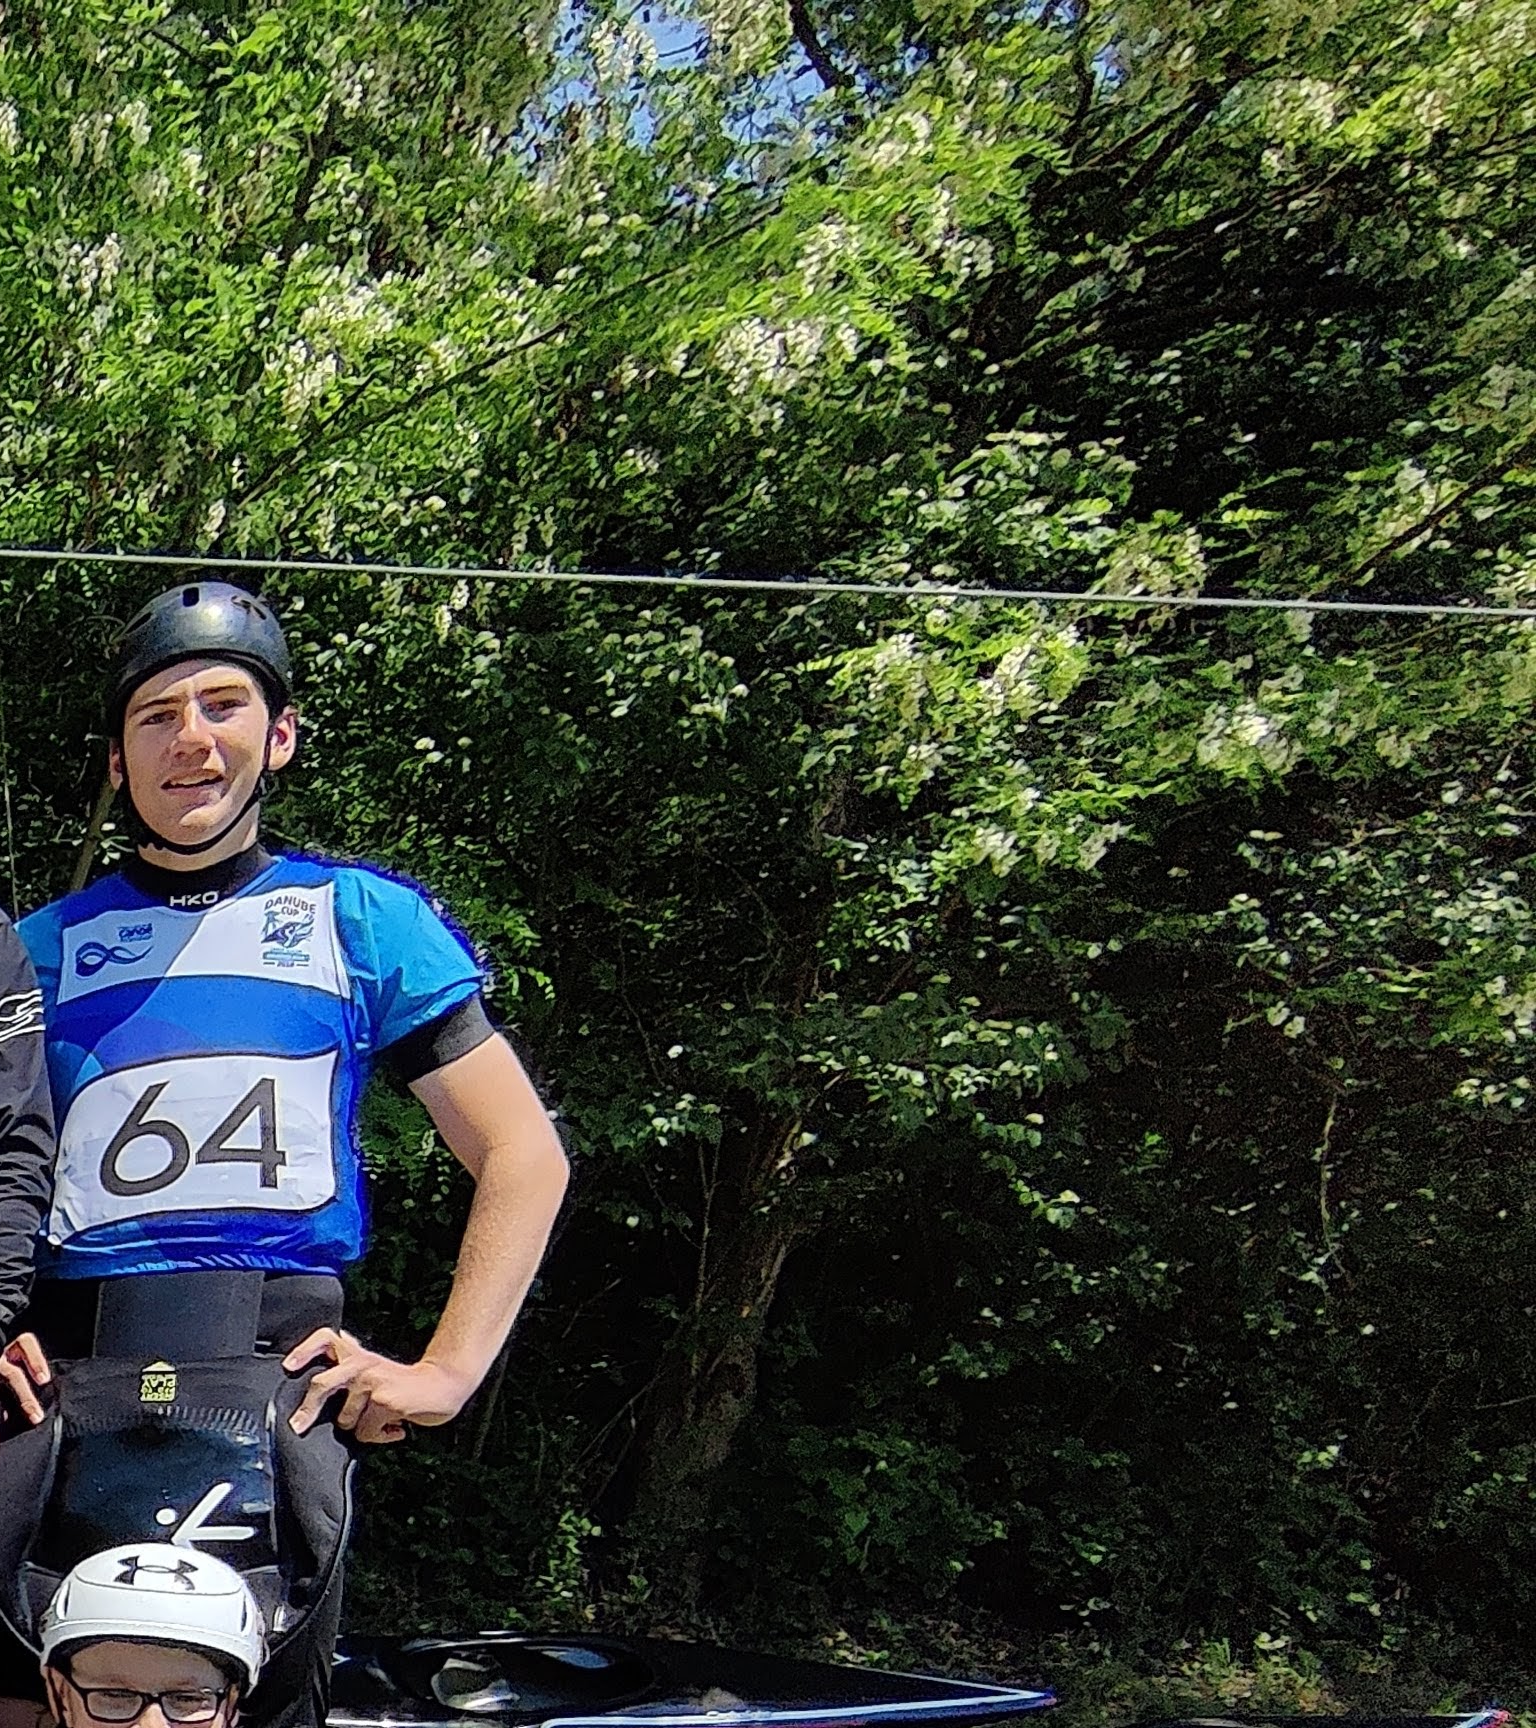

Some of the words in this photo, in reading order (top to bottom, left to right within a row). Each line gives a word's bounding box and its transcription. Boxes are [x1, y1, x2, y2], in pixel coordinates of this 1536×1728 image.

[264, 896, 317, 914] DANUBE
[280, 906, 299, 917] CUP
[99, 1076, 287, 1197] 64
